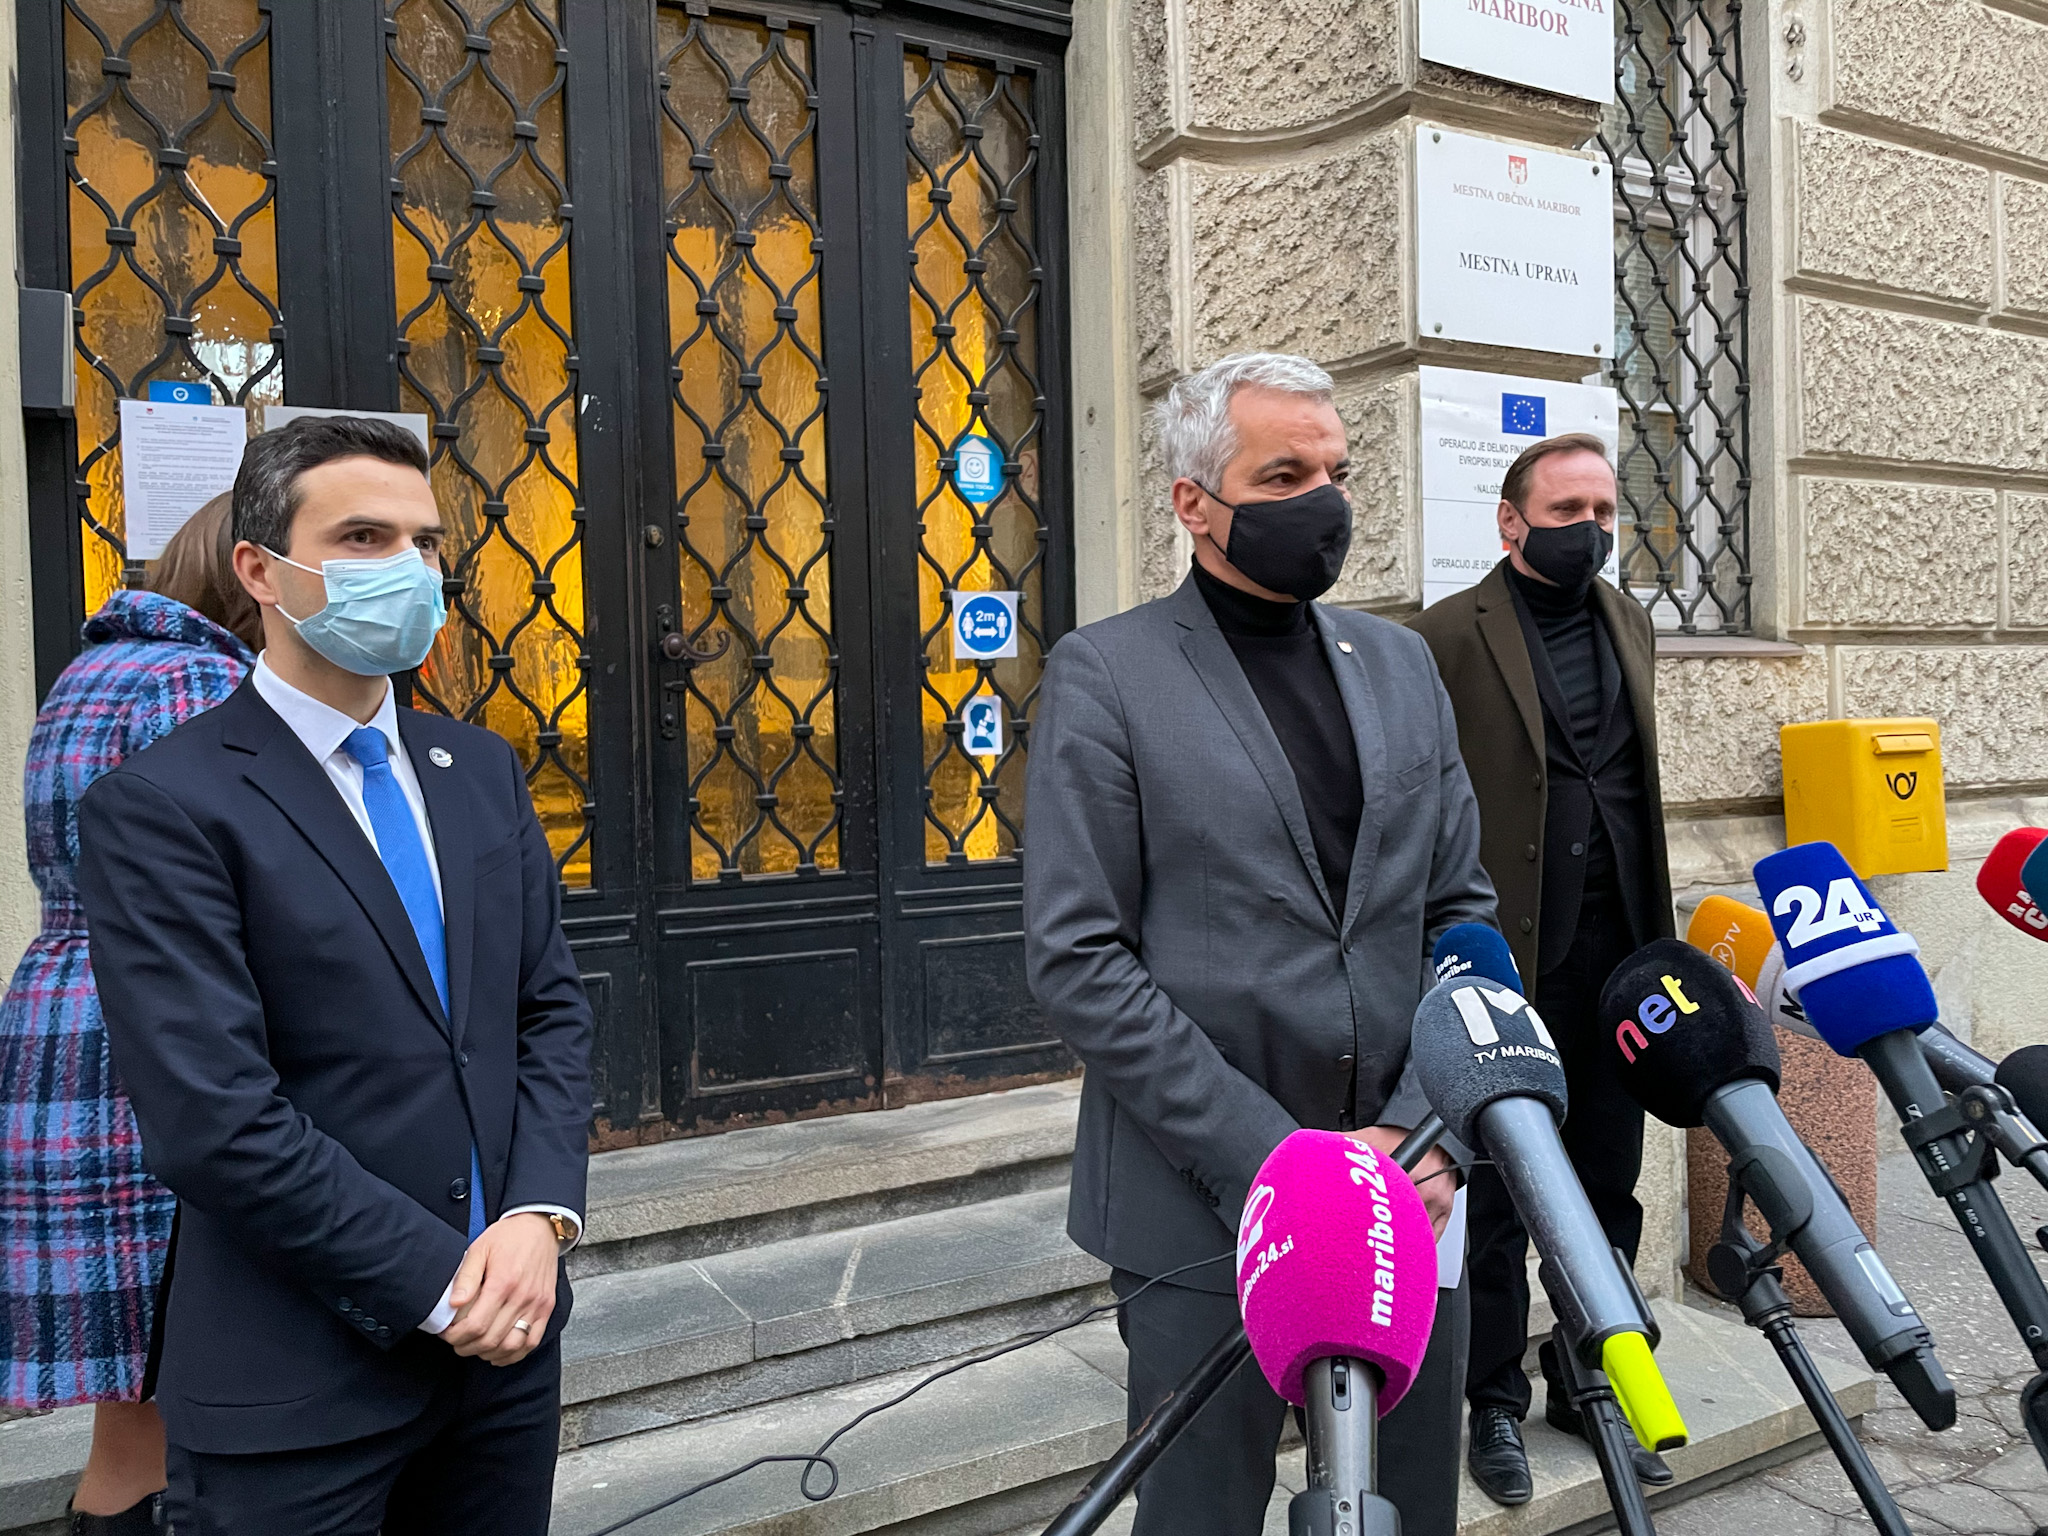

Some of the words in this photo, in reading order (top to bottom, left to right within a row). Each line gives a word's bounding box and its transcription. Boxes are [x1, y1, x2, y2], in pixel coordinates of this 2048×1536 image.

[1452, 183, 1495, 201] MESTNA
[1497, 191, 1535, 208] OBČINA
[1537, 199, 1582, 216] MARIBOR
[1459, 251, 1520, 277] MESTNA
[1525, 262, 1579, 286] UPRAVA
[1439, 437, 1477, 452] OPERACIJO
[1478, 441, 1486, 452] JE
[1486, 442, 1509, 454] DELNO
[1459, 454, 1492, 467] EVROPSKI
[1432, 558, 1471, 569] OPERACIJO
[1472, 560, 1480, 570] JE
[976, 609, 996, 622] 2m
[1853, 911, 1875, 924] UR
[1723, 921, 1742, 943] TV
[1616, 974, 1700, 1065] net
[1474, 1048, 1498, 1065] TV
[1500, 1045, 1562, 1070] MARIBOR
